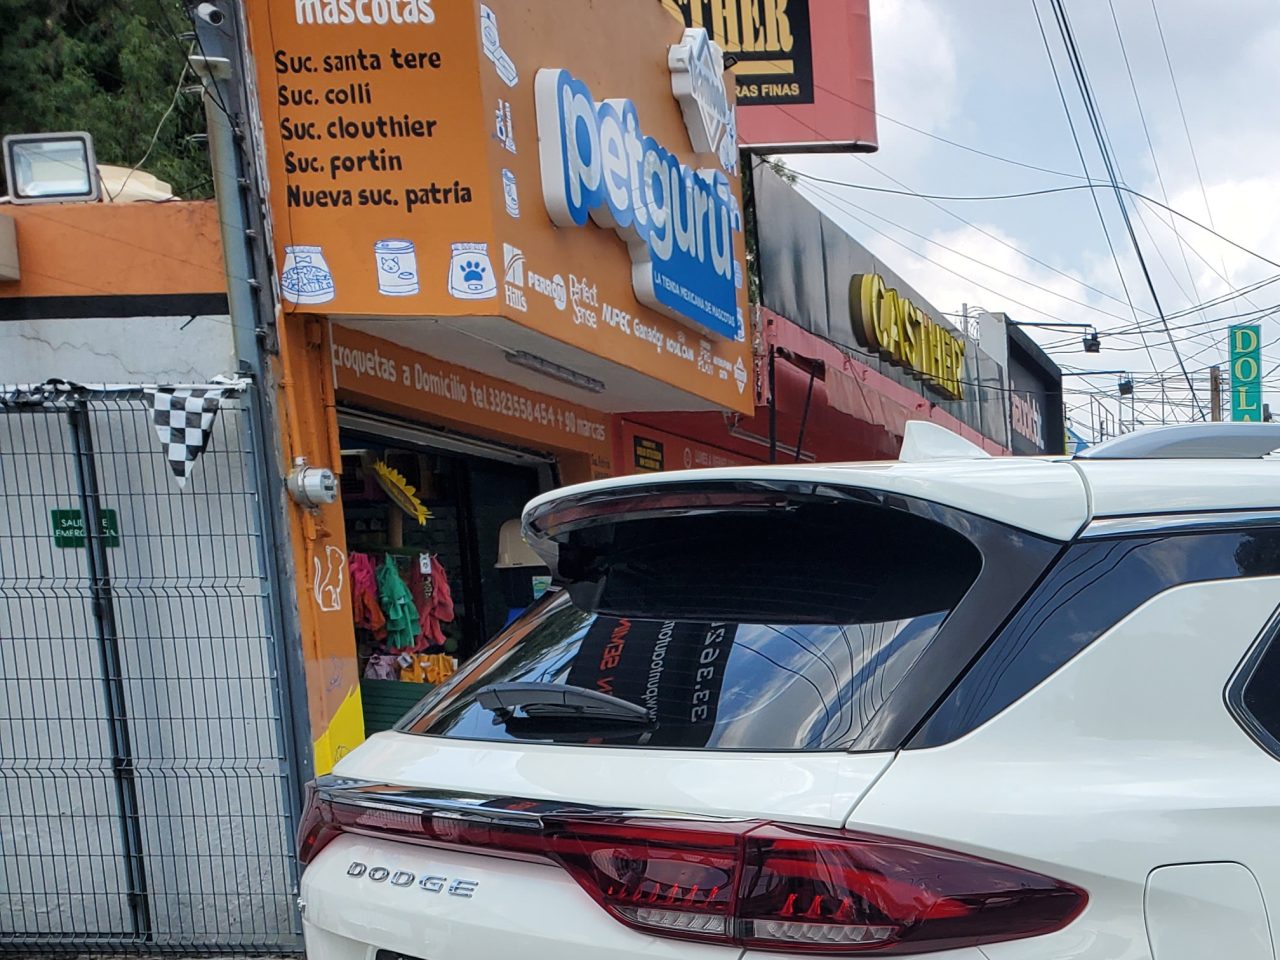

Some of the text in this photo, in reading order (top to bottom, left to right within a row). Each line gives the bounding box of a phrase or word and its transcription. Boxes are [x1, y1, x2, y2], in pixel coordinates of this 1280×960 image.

[294, 0, 436, 25] mascotas
[274, 48, 441, 74] Suc. santa tere
[278, 85, 319, 106] Suc.
[761, 83, 800, 97] FINAS
[279, 114, 437, 141] Suc. clouthier
[284, 151, 324, 174] Suc.
[287, 181, 473, 213] Nueva suc. patria
[568, 274, 598, 307] Perfect
[572, 296, 597, 328] Sense
[602, 303, 631, 335] NUPEC
[853, 273, 965, 400] CASTHER
[402, 365, 411, 386] a
[414, 363, 467, 403] Domicilio
[1234, 329, 1258, 421] DOL
[347, 861, 479, 899] DODGE
